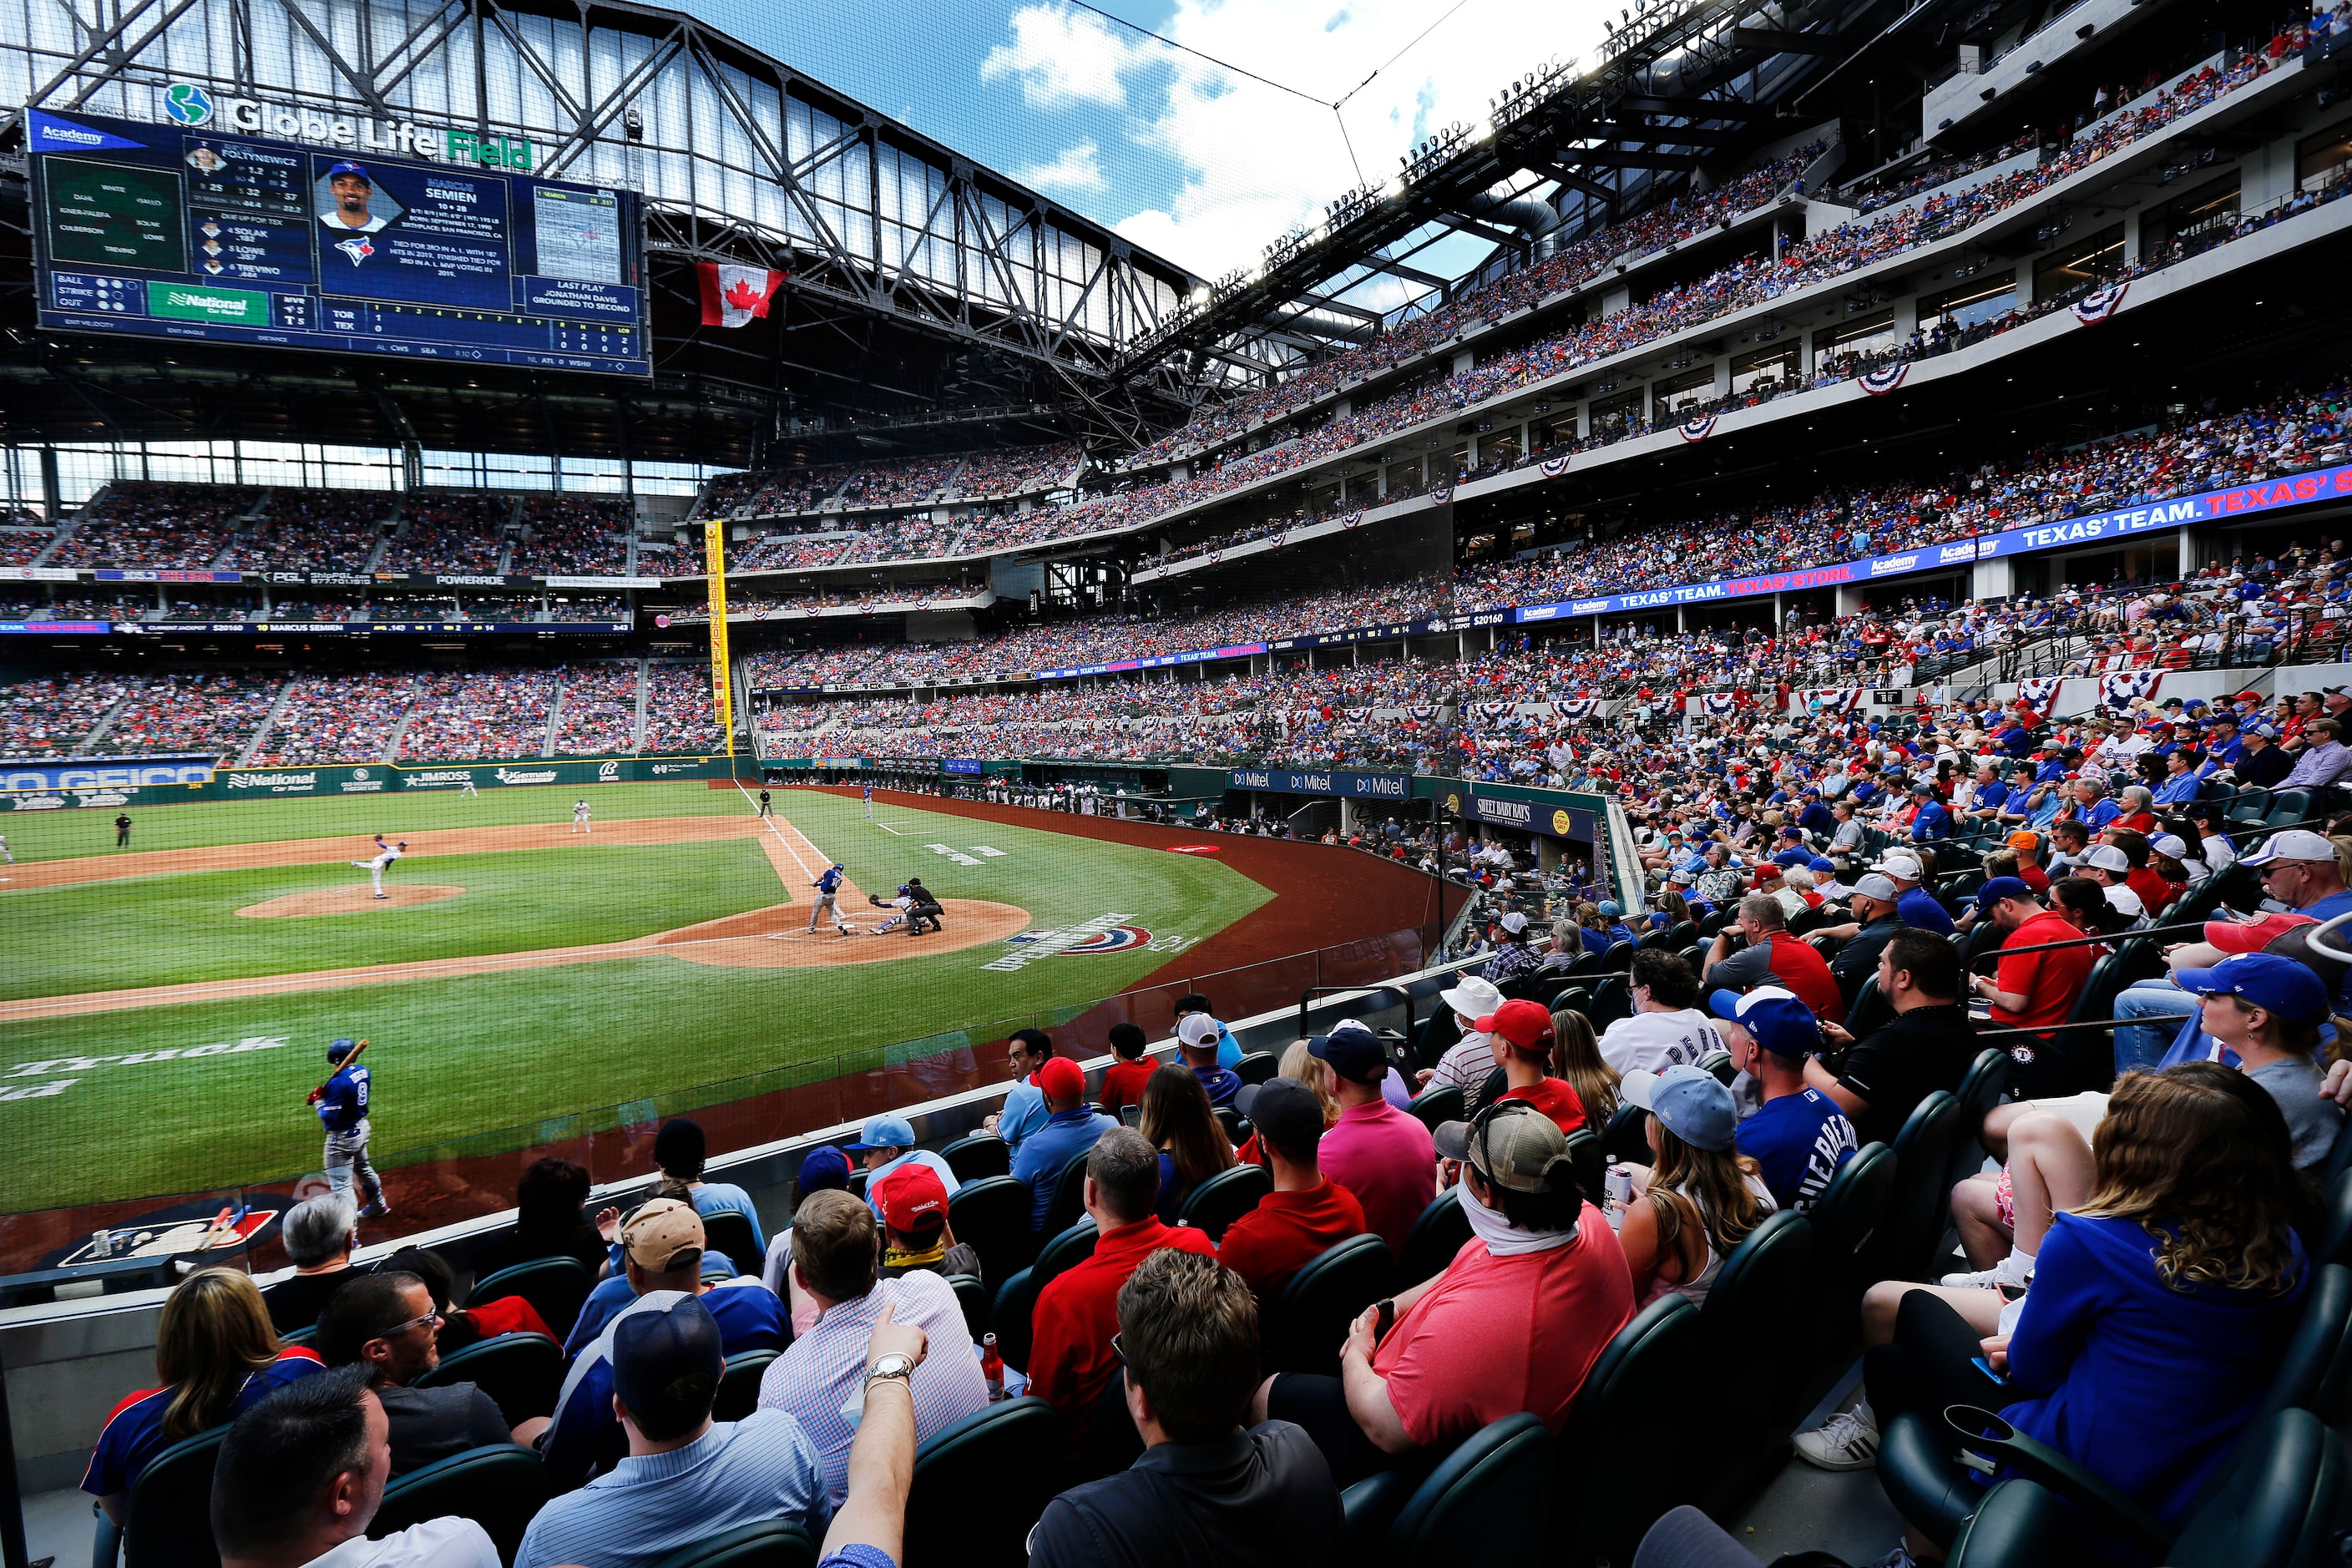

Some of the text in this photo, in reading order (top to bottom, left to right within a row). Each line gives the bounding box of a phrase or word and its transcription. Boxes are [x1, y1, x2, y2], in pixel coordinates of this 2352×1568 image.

[42, 125, 103, 145] Academy
[233, 98, 532, 169] Globe Life Field
[221, 149, 297, 167] FOLTYNEWICZ
[100, 184, 126, 194] WHITE
[209, 183, 224, 192] 25
[246, 188, 260, 196] 32
[284, 193, 297, 201] 57
[426, 188, 477, 204] SEMIEN
[220, 213, 238, 221] DUE
[430, 218, 466, 228] SEPTEMBER
[58, 224, 104, 235] CULBERSON
[234, 227, 269, 238] SOLAK
[392, 240, 409, 248] TIED
[104, 245, 138, 255] TREVINO
[235, 245, 266, 255] LOWE
[437, 253, 469, 263] FINISHED
[235, 263, 281, 276] TREVINO
[456, 264, 483, 272] VOTING
[57, 276, 83, 285] BALL
[58, 286, 94, 297] STRIKE
[557, 281, 604, 292] LAST PLAY
[58, 297, 83, 307] OUT
[185, 294, 248, 311] National
[283, 296, 306, 305] MVR
[544, 290, 618, 304] JONATHAN DAVIS
[296, 306, 305, 314] 5
[532, 296, 630, 313] GROUNDED TO SECOND
[332, 310, 355, 320] TOR
[297, 316, 306, 326] 5
[333, 321, 355, 331] TEX
[601, 345, 608, 353] 0
[390, 344, 409, 353] CWS
[420, 346, 438, 355] SEA
[541, 357, 555, 366] ATL
[2022, 475, 2327, 548] TEXAS' TEAM. TEXAS'
[1870, 554, 1918, 573] Academy
[122, 570, 214, 582] 105.3 THE FAN
[272, 572, 306, 582] PGL
[436, 574, 506, 585] POWERADE
[1620, 566, 1854, 608] TEXAS' TEAM. TEXAS' STORE.
[1571, 599, 1608, 612] Academy
[1523, 606, 1556, 618] Academy
[1474, 613, 1503, 625] $20160
[256, 624, 269, 632] 10
[270, 624, 307, 632] MARCUS
[308, 624, 345, 632] SEMIEN
[1274, 640, 1293, 650] SEMIEN
[1329, 635, 1342, 643] .143
[1377, 629, 1382, 637] 2
[1402, 625, 1409, 634] 14
[1200, 650, 1218, 660] TEAM.
[248, 771, 316, 787] National
[513, 770, 556, 779] Germania
[1246, 772, 1268, 788] Mitel
[58, 766, 214, 797] GEICO
[1304, 774, 1332, 792] Mitel
[1373, 777, 1404, 796] Mitel
[1477, 798, 1530, 822] SWEET BABY RAY'S
[1483, 816, 1504, 824] GOURMET
[357, 1081, 368, 1106] 8
[2014, 1088, 2020, 1096] 5
